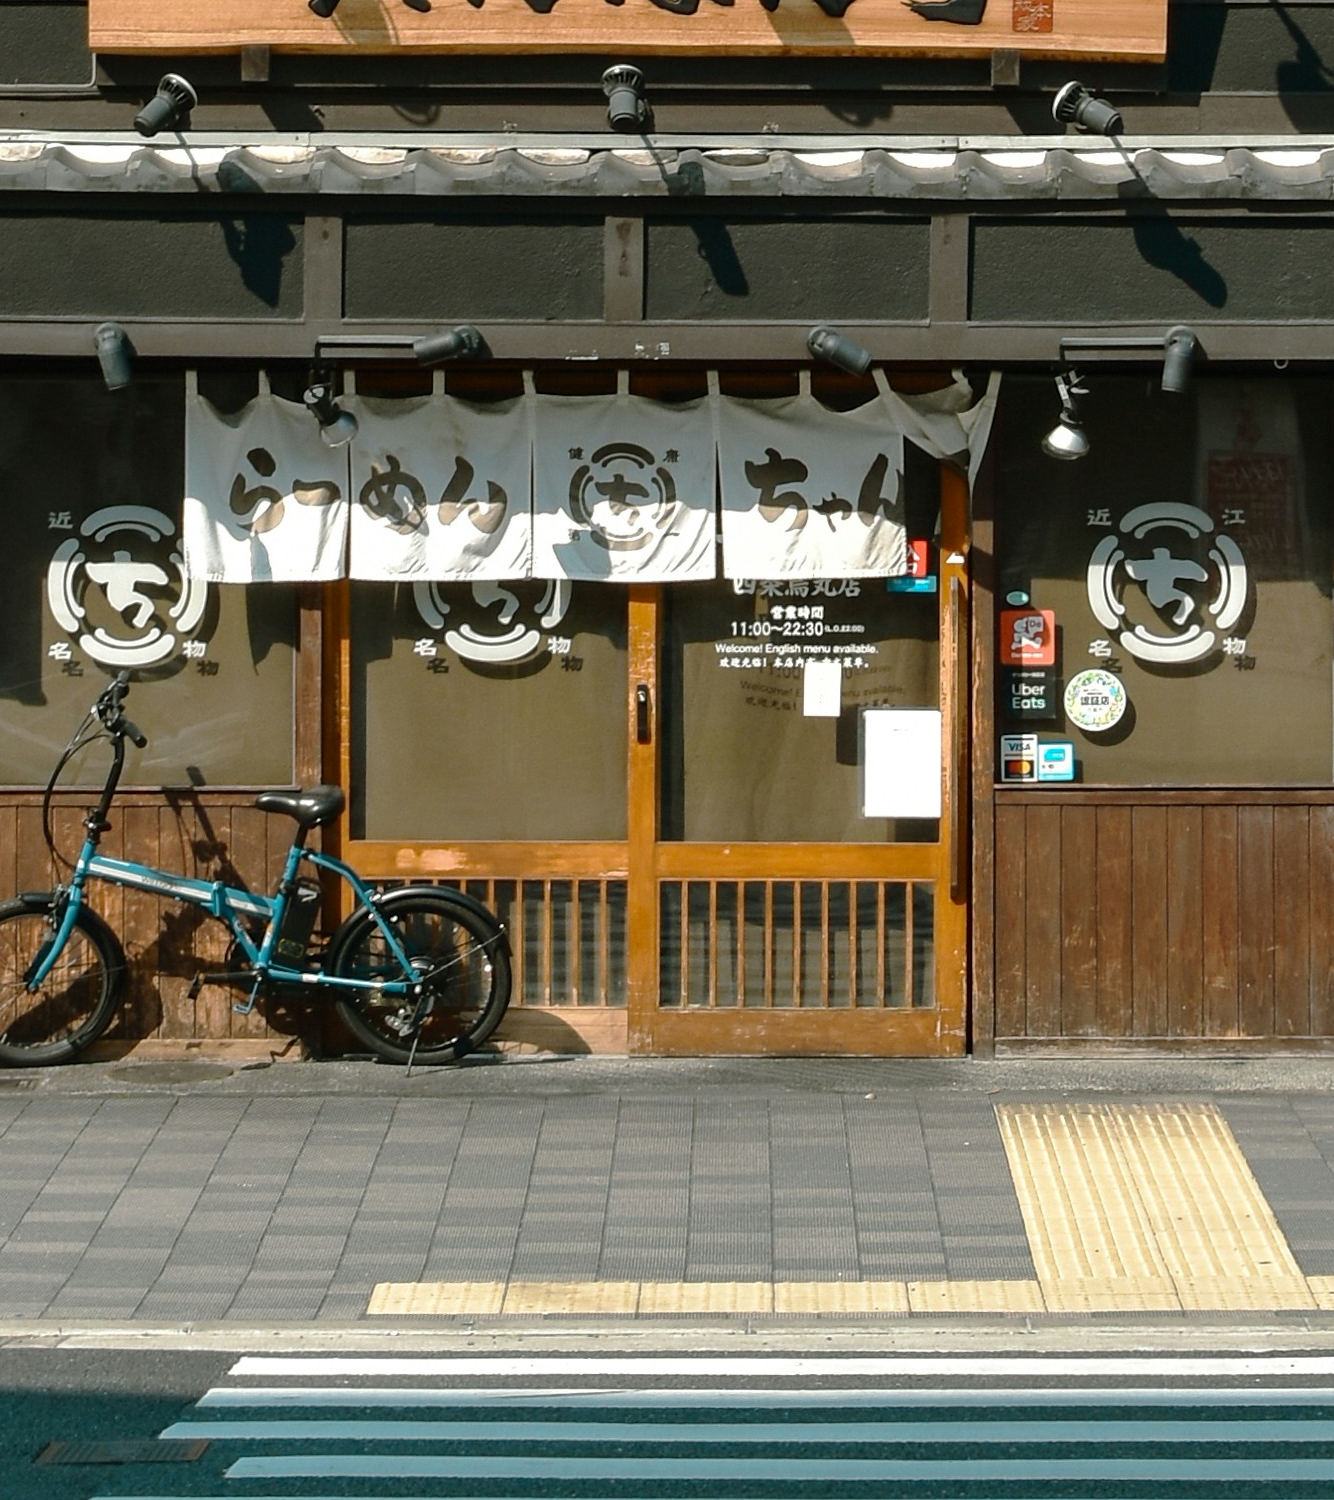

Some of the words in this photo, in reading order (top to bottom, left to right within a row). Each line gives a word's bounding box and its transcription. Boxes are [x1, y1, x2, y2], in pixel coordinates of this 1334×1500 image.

[230, 448, 507, 535] らーめん
[48, 511, 73, 529] 近
[1087, 509, 1112, 526] 近
[1222, 509, 1246, 525] 江
[85, 550, 169, 628] ち
[1124, 548, 1209, 625] ち
[48, 642, 72, 660] 名
[182, 640, 206, 657] 物
[414, 638, 437, 656] 名
[547, 636, 571, 654] 物
[715, 643, 763, 654] Welcome!
[765, 643, 800, 656] English
[803, 646, 830, 654] menu
[832, 643, 879, 654] available.
[1088, 639, 1112, 657] 名
[1222, 637, 1246, 655] 物
[1011, 682, 1046, 696] Uber
[1011, 697, 1046, 709] Eats
[1008, 742, 1031, 751] VISA
